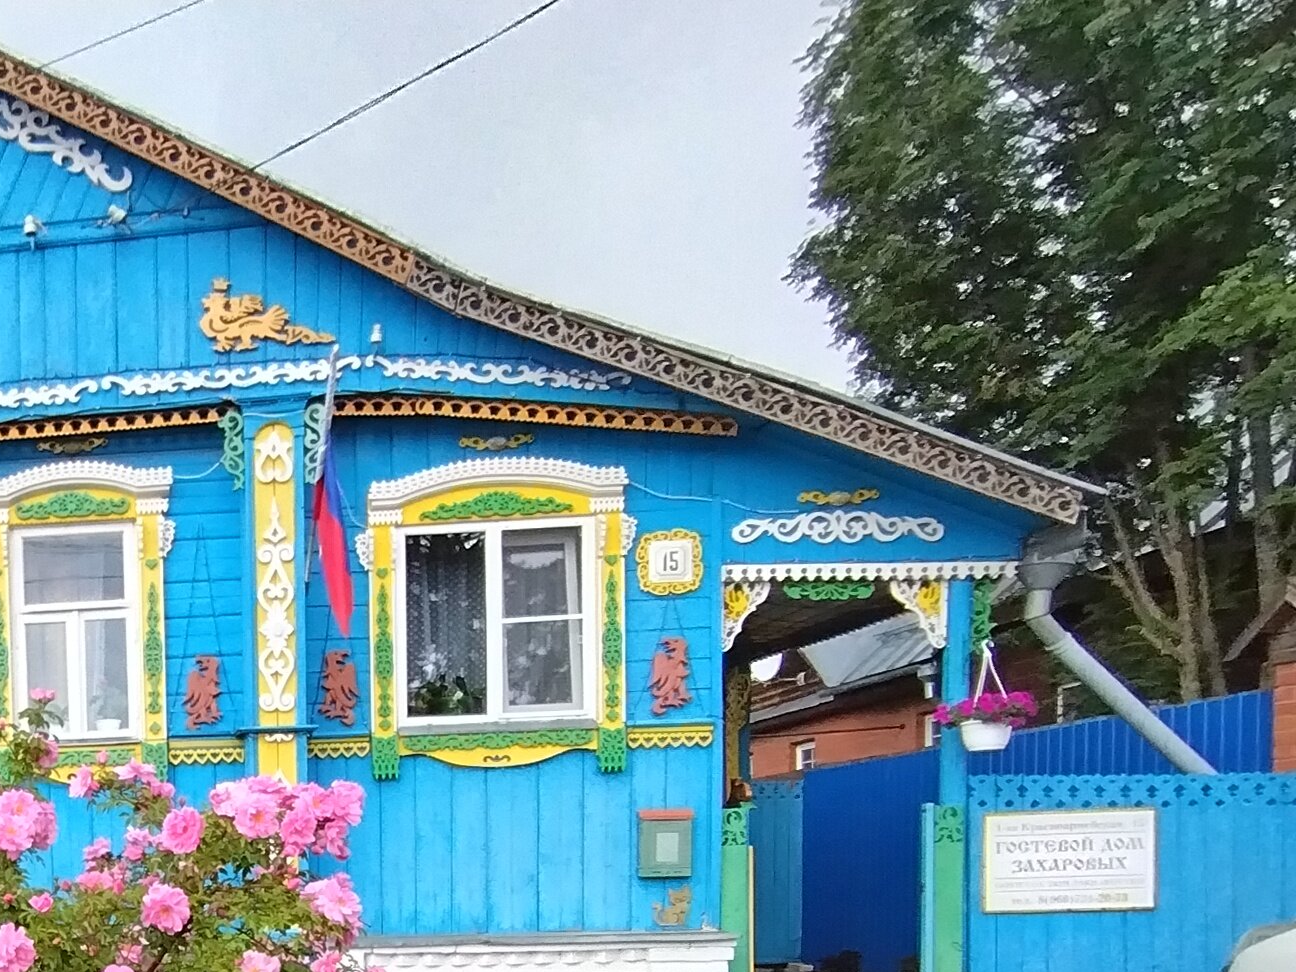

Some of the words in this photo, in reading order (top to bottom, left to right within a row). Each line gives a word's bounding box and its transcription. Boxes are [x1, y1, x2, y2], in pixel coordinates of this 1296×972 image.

[663, 550, 678, 571] 15
[996, 837, 1093, 854] ГОСТЕВОЙ
[1101, 837, 1145, 852] ДОМ
[1011, 856, 1128, 874] ЗАХАРОВЫХ
